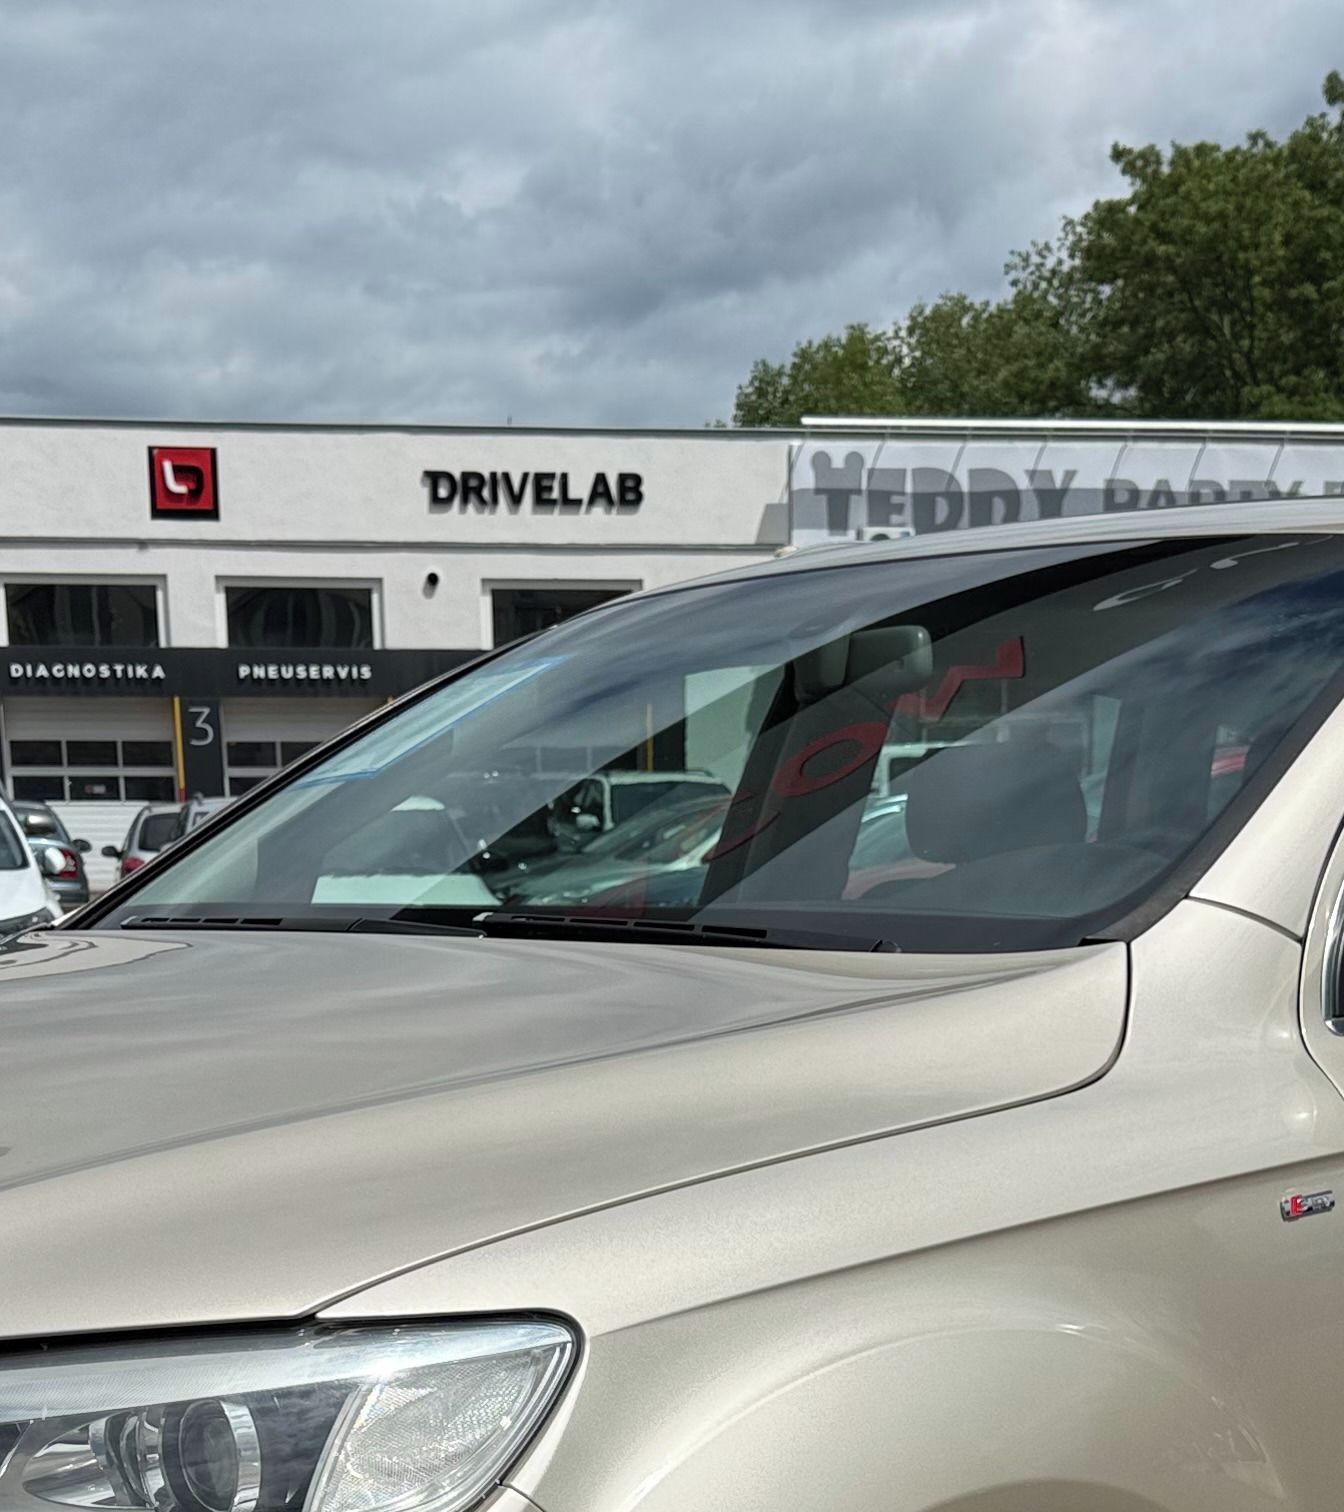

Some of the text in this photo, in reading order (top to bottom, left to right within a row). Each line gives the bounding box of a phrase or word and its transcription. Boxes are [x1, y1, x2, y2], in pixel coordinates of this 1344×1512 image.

[422, 470, 644, 506] DRIVELAB
[811, 451, 1078, 536] TEDDY
[9, 662, 167, 679] DIAGNOSTIKA
[238, 663, 373, 680] PNEUSERVIS
[187, 706, 214, 746] 3
